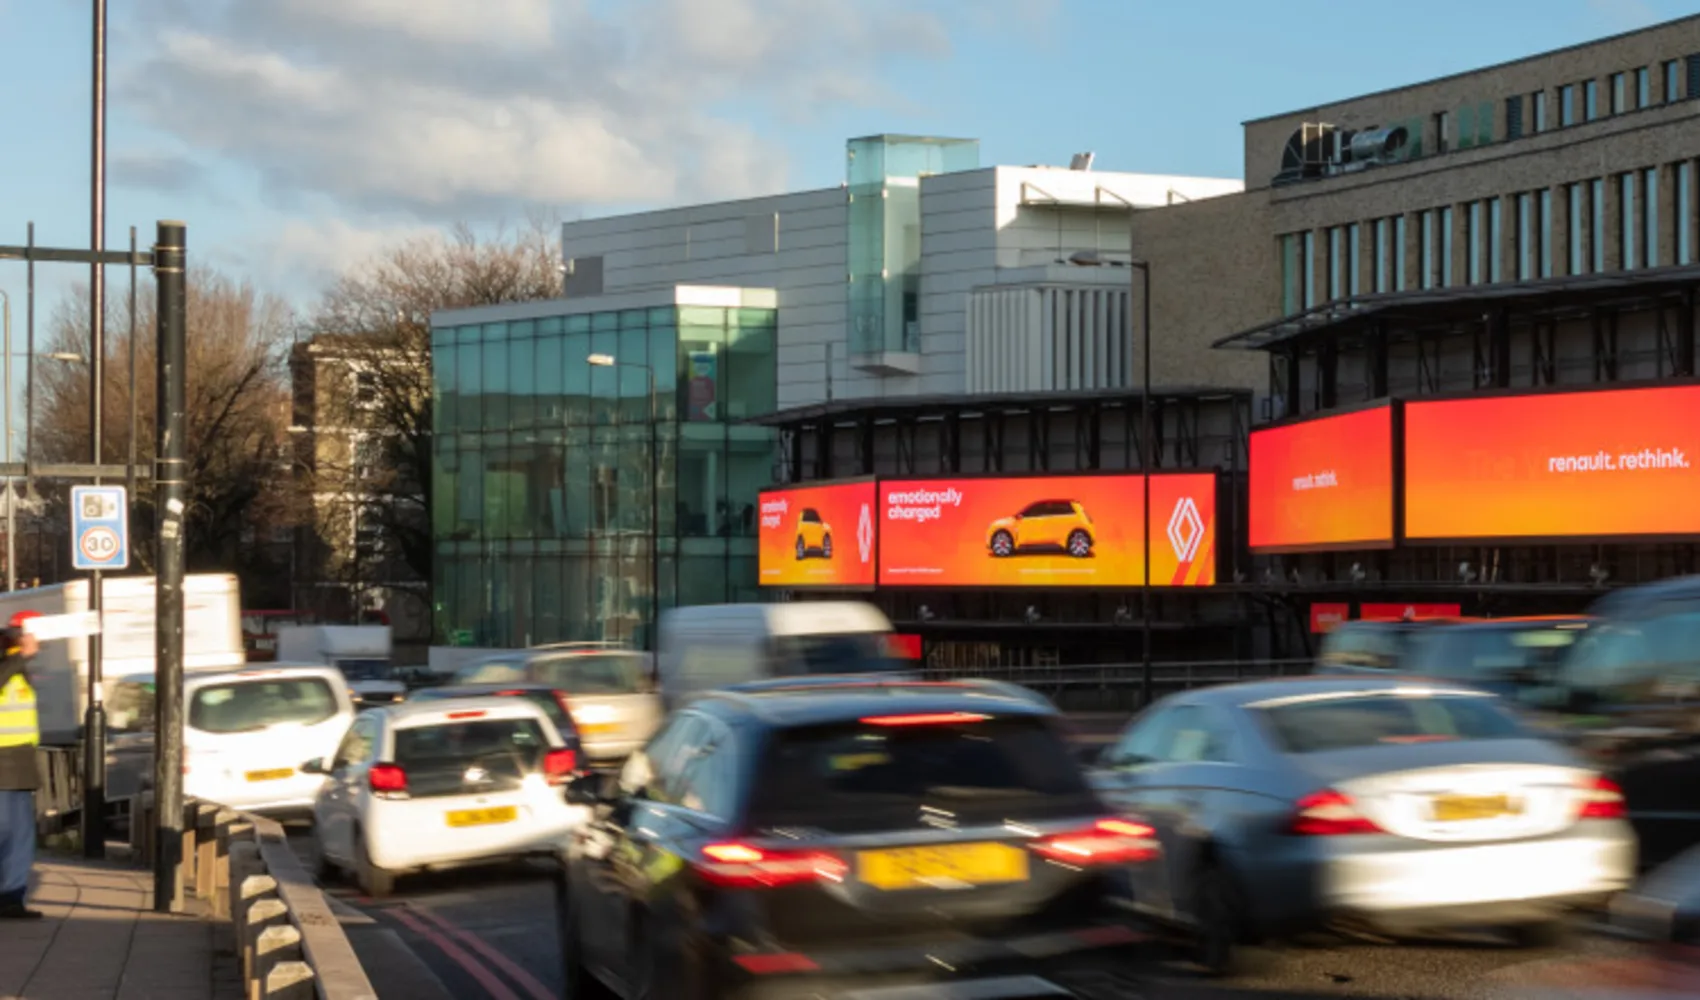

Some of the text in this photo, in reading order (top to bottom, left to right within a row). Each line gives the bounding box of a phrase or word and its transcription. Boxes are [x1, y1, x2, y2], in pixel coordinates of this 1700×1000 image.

[1548, 449, 1616, 473] renault.
[1617, 446, 1690, 471] rethink.
[888, 487, 963, 506] emotionally
[888, 503, 941, 522] charged
[87, 536, 114, 552] 30
